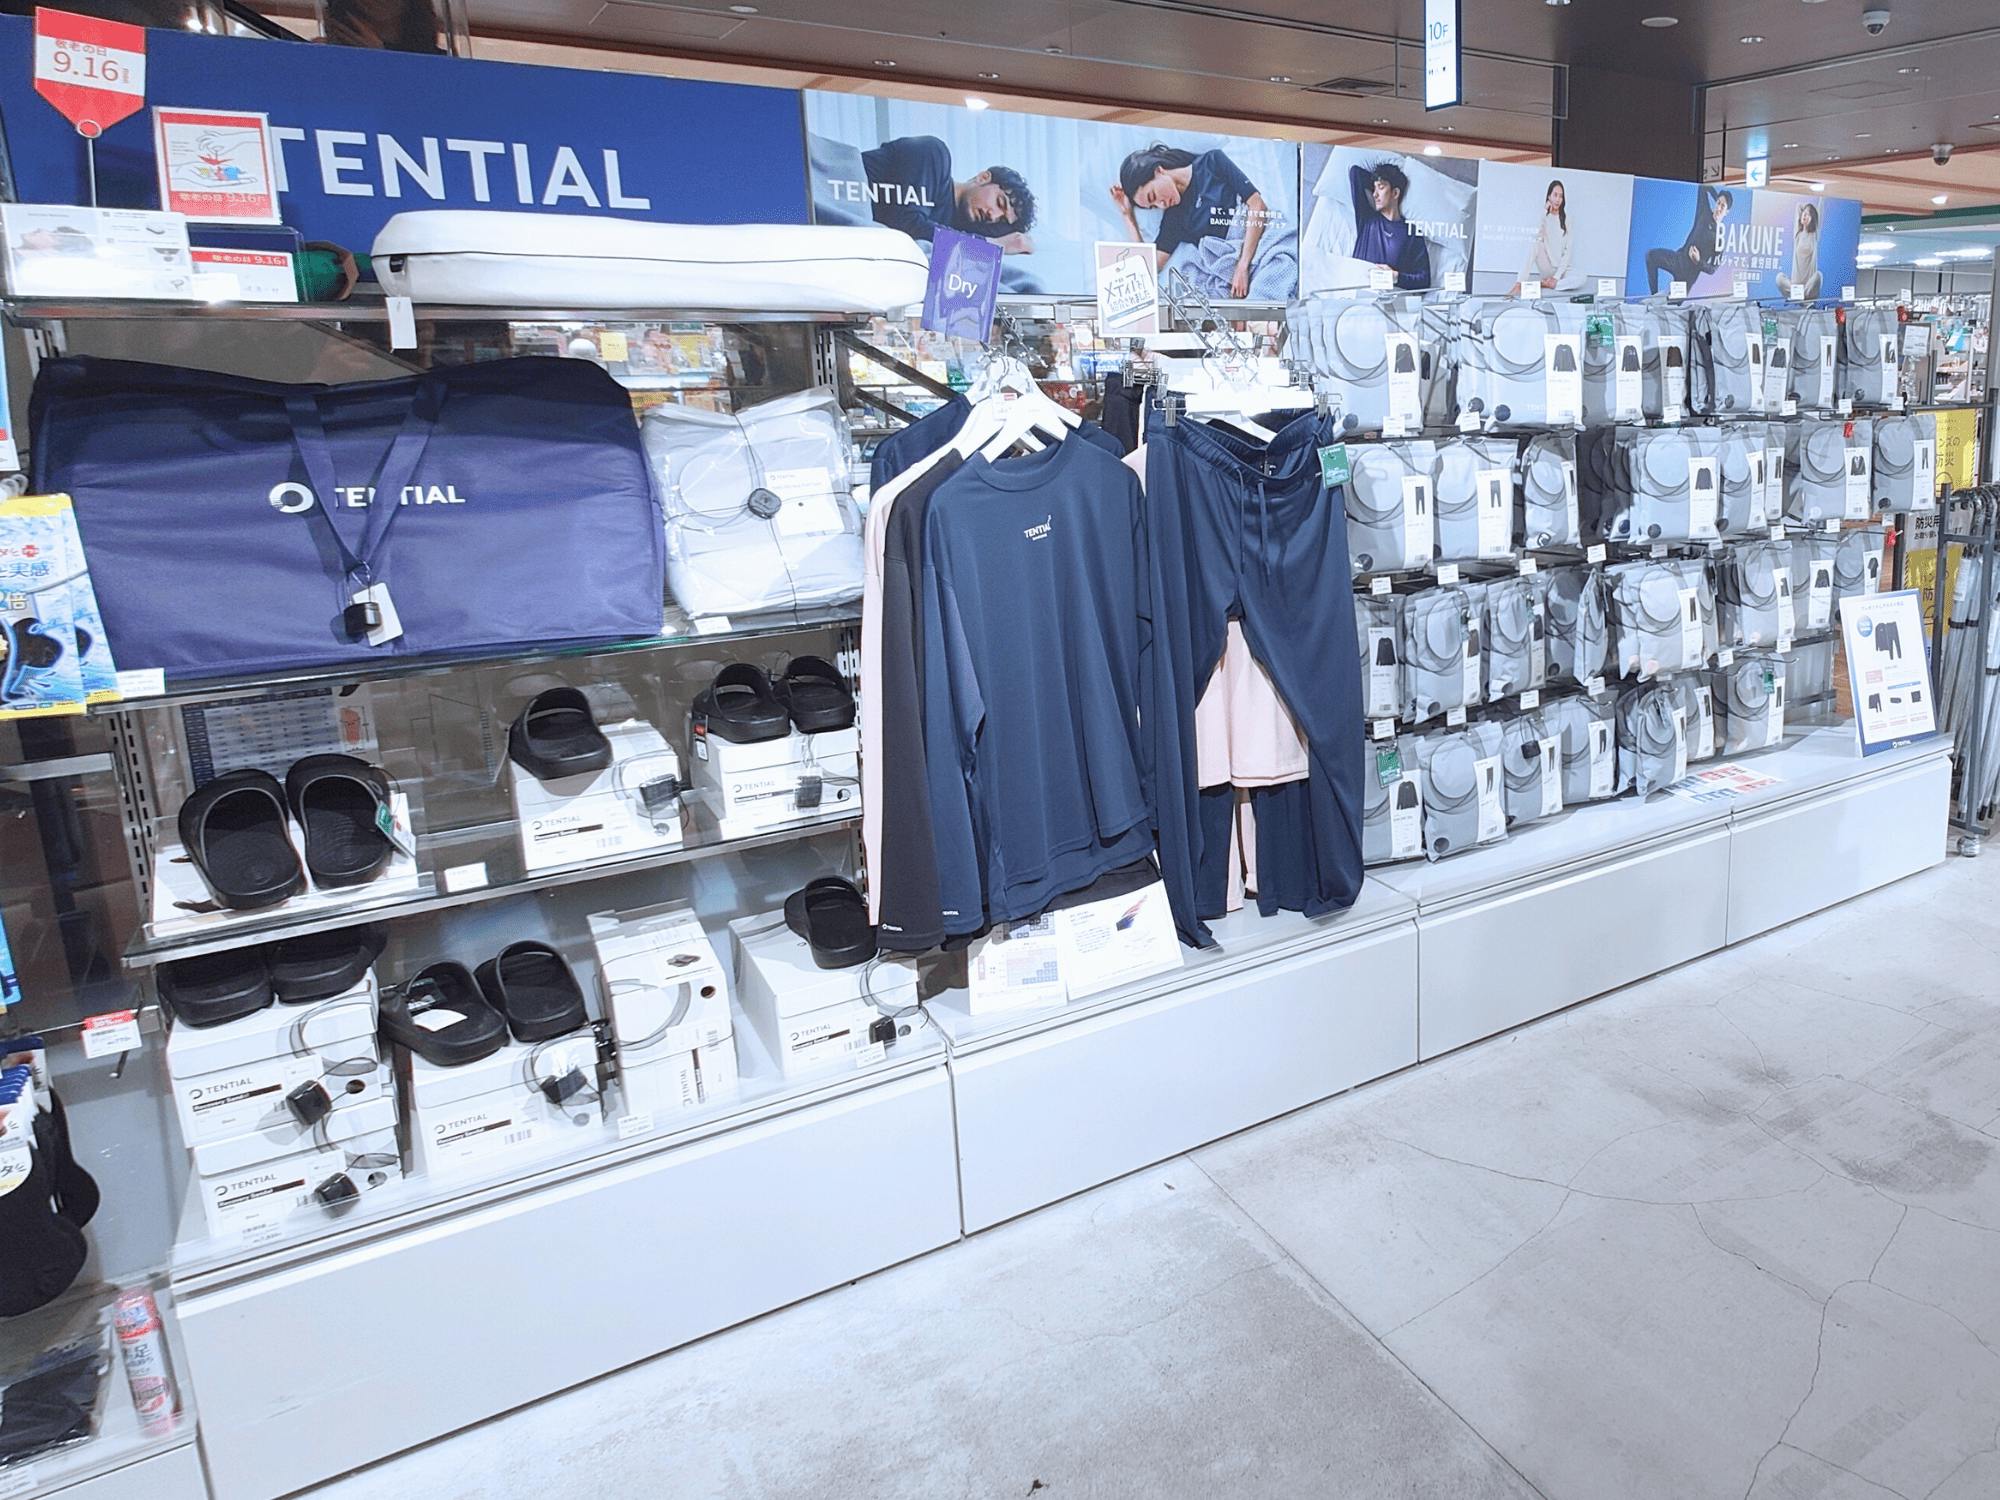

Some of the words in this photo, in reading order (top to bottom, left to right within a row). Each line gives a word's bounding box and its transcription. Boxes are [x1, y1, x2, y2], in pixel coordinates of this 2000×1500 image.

[1428, 20, 1449, 41] 10F
[53, 51, 119, 82] 9.16
[270, 126, 652, 210] TENTIAL
[827, 179, 936, 208] TENTIAL
[1404, 219, 1469, 240] TENTIAL
[1715, 222, 1784, 256] BAKUNE
[948, 272, 978, 299] Dry
[1023, 514, 1052, 539] TENTIAL
[545, 816, 583, 827] TENTIAL
[206, 1078, 253, 1095] TENTIAL
[448, 1113, 488, 1130] TENTIAL
[230, 1173, 277, 1190] TENTIAL
